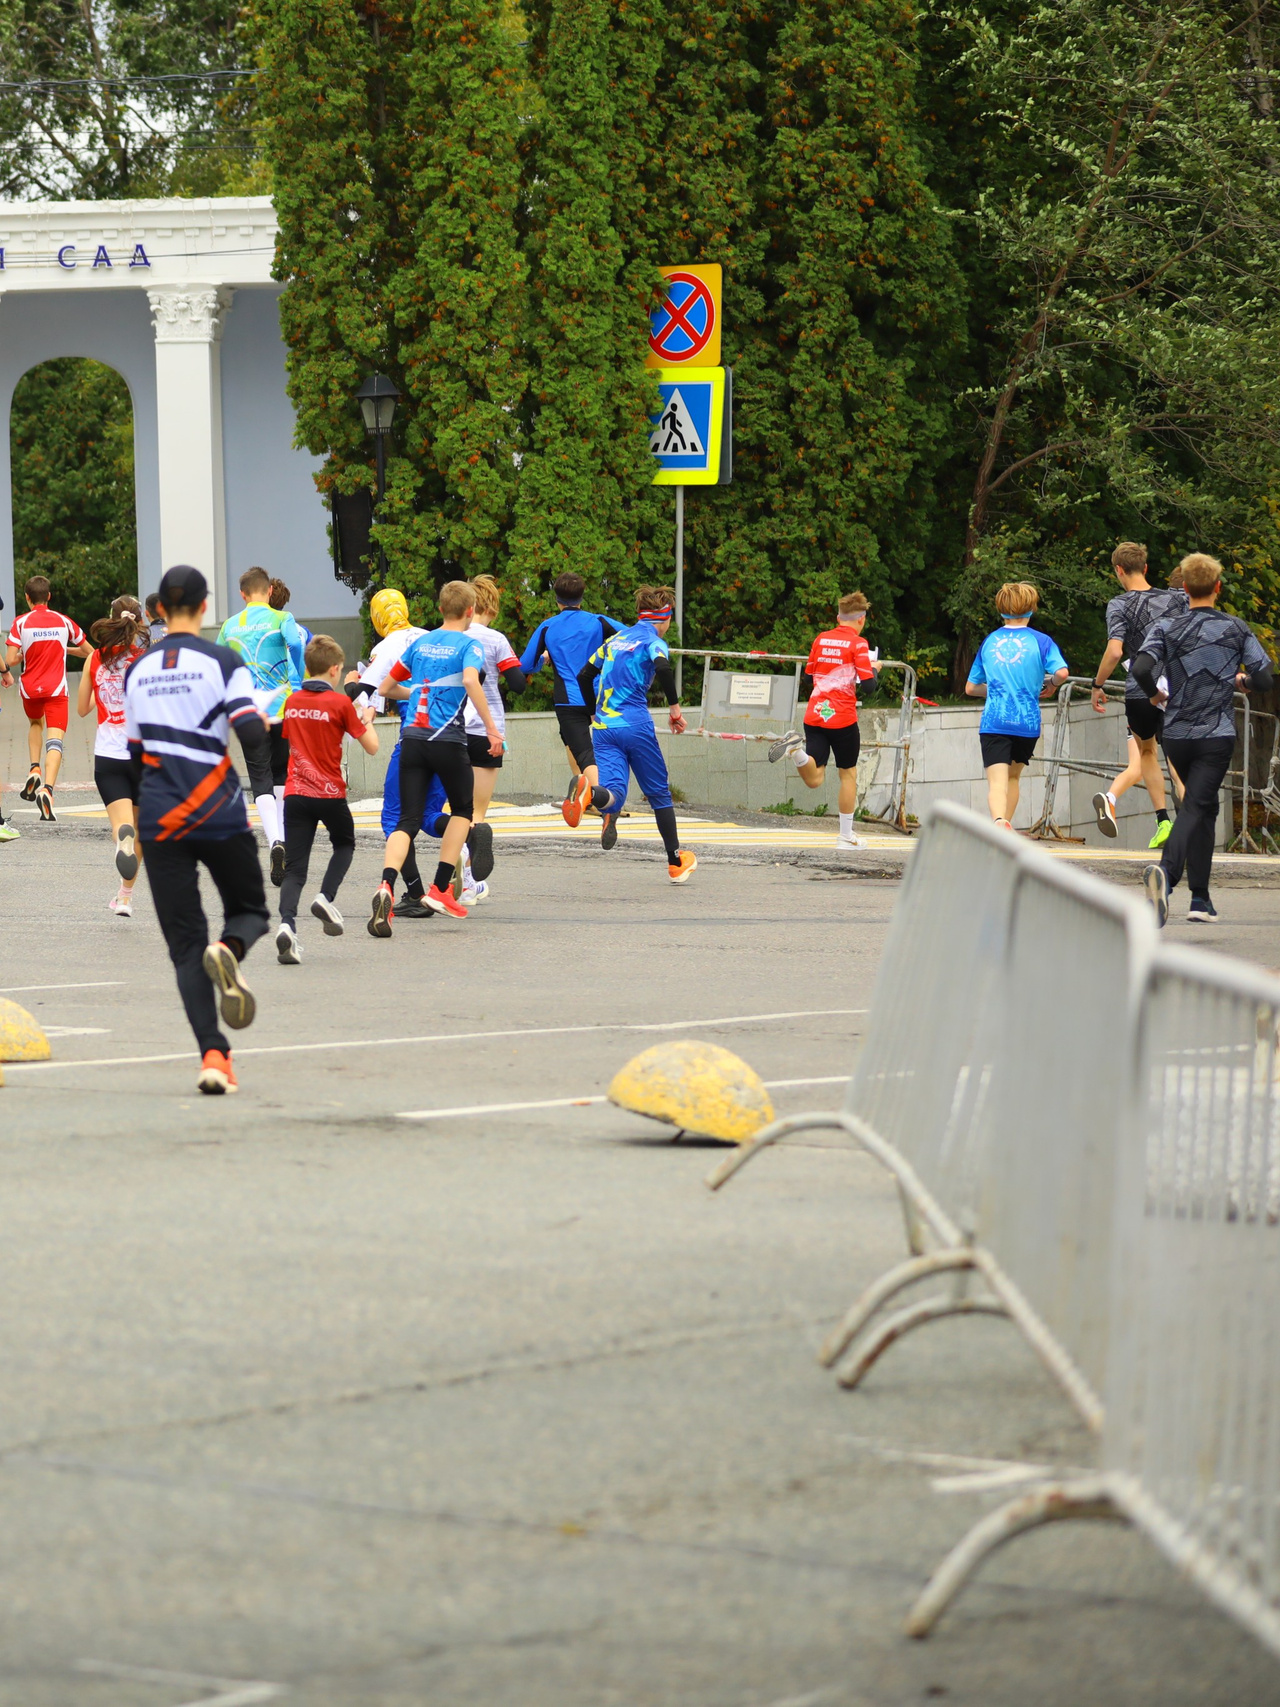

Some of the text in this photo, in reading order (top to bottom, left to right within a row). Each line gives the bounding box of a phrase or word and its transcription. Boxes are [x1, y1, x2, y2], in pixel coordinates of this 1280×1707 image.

[56, 243, 152, 270] САД
[32, 630, 60, 638] RUSSIA
[418, 645, 455, 656] КОМПАС
[284, 708, 330, 722] МОСКВА
